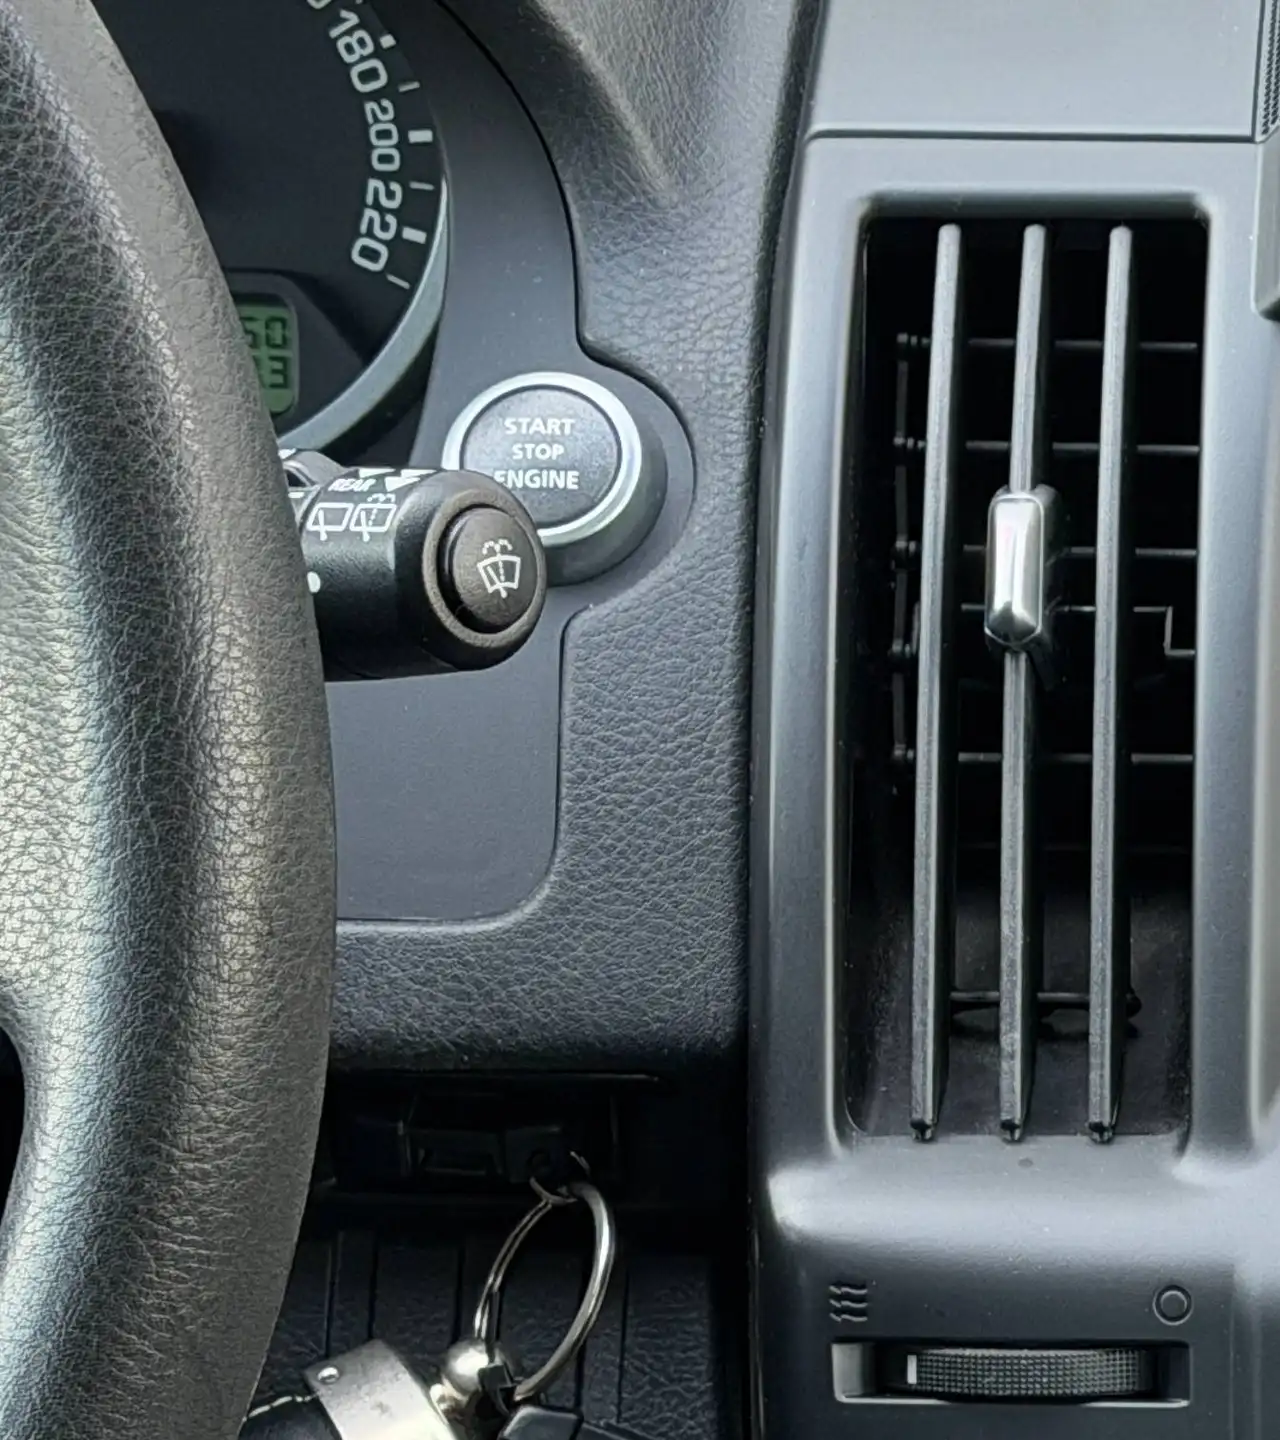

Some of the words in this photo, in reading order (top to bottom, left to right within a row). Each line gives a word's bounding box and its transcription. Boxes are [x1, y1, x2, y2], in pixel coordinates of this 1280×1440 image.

[329, 8, 388, 93] 180
[364, 98, 401, 172] 200
[351, 178, 403, 272] 220
[504, 417, 575, 436] START
[512, 444, 564, 460] STOP
[494, 470, 580, 490] ENGINE
